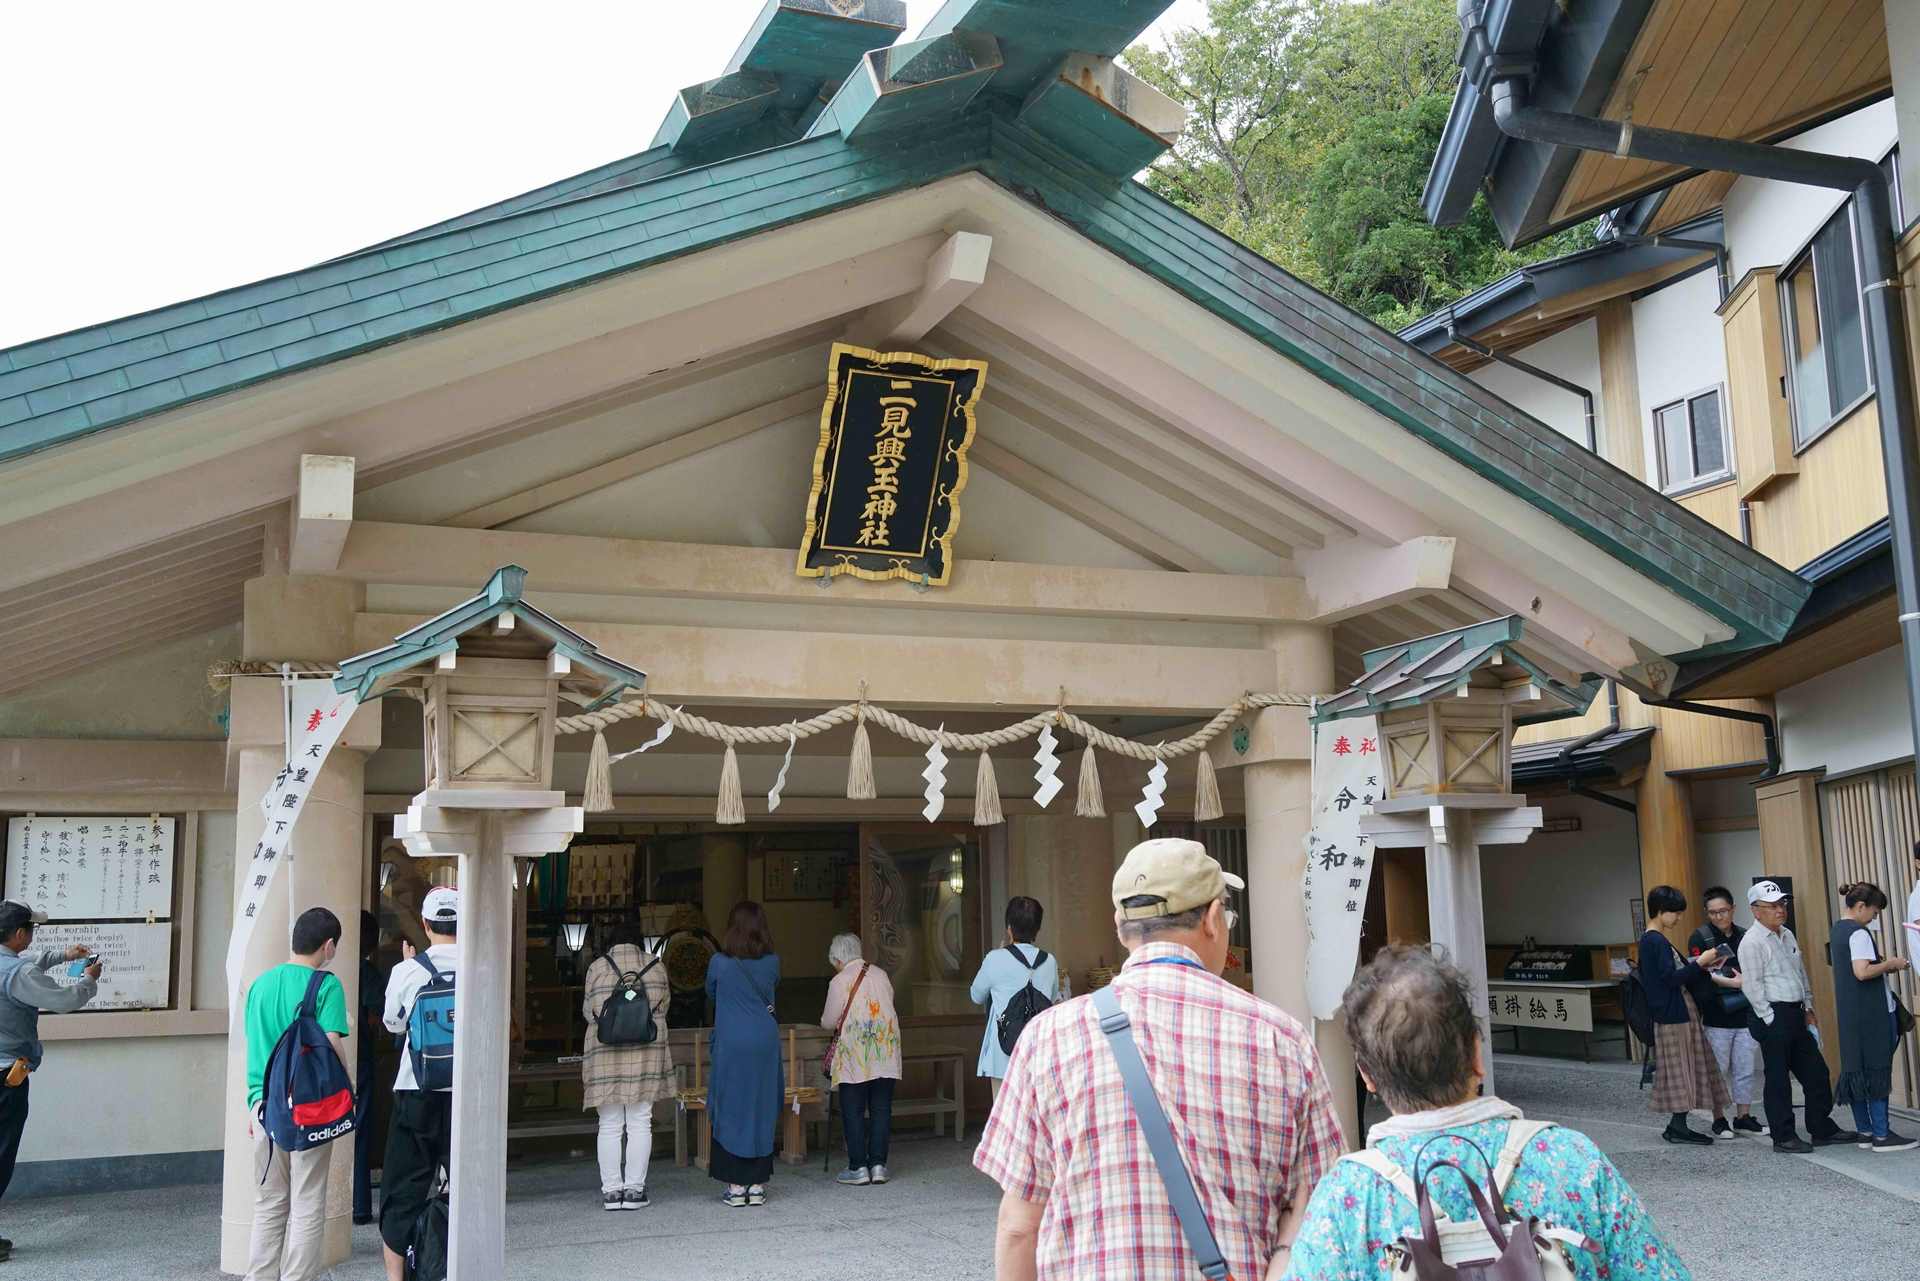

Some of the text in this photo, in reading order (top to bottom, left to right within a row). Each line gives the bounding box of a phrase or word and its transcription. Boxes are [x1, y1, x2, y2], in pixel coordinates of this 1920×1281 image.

[855, 380, 918, 547] 二見興玉神社
[245, 744, 323, 918] 天皇陛下御即位
[1319, 786, 1358, 871] 令和
[1345, 775, 1377, 912] 天皇下御即位
[64, 927, 99, 935] worship
[308, 1119, 352, 1142] adidas
